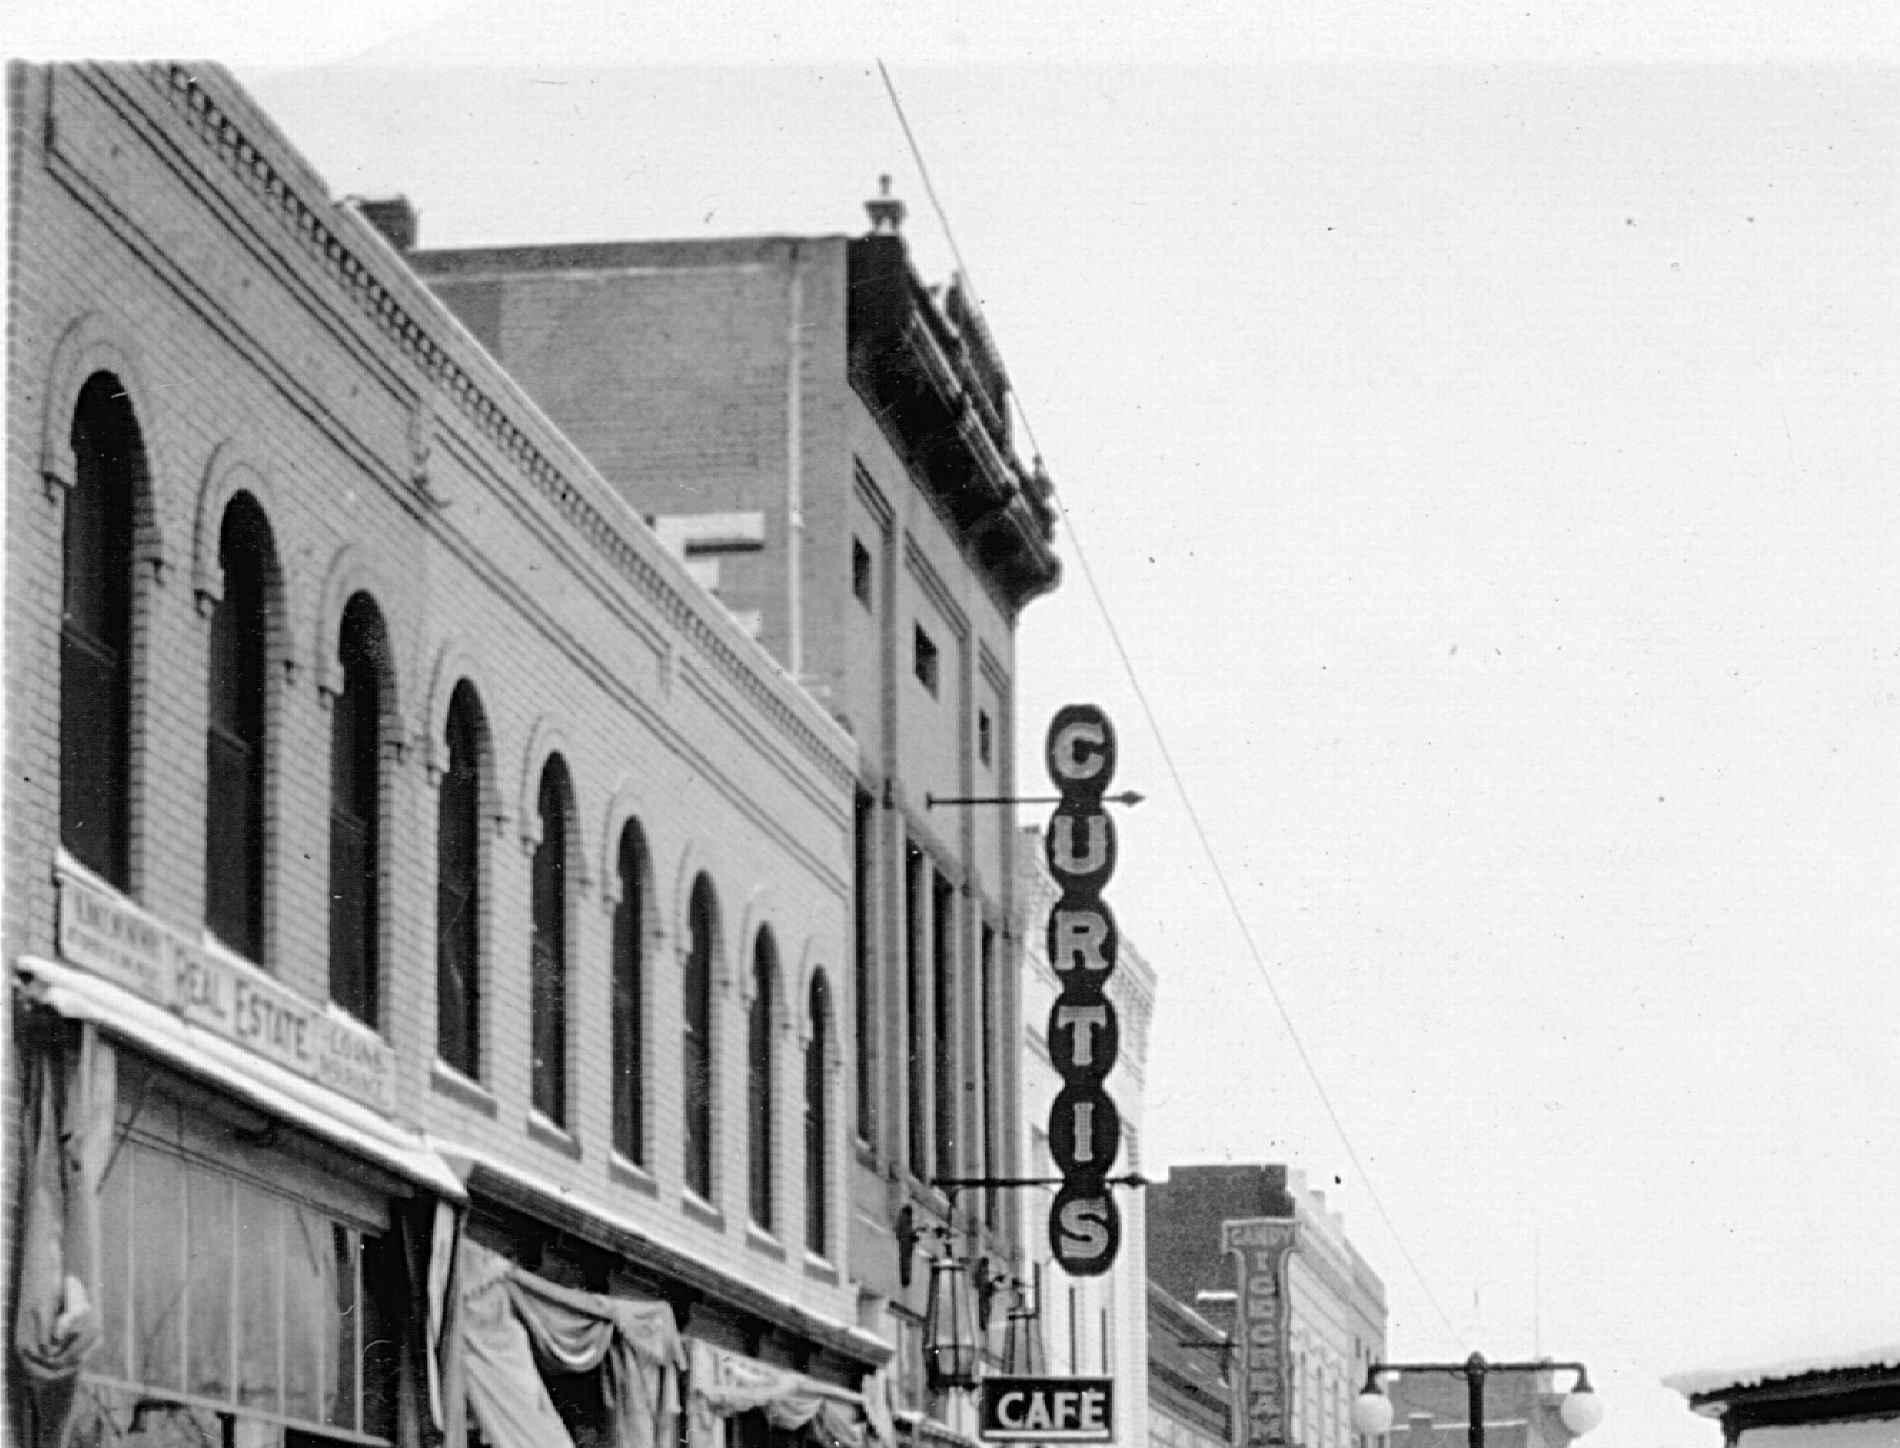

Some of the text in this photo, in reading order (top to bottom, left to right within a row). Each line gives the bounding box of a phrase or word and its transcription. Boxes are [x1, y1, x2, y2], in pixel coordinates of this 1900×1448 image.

[174, 946, 228, 1018] REAL
[234, 978, 308, 1062] ESTATE
[1054, 721, 1109, 1259] CURTIS
[1249, 1323, 1281, 1440] CREAM
